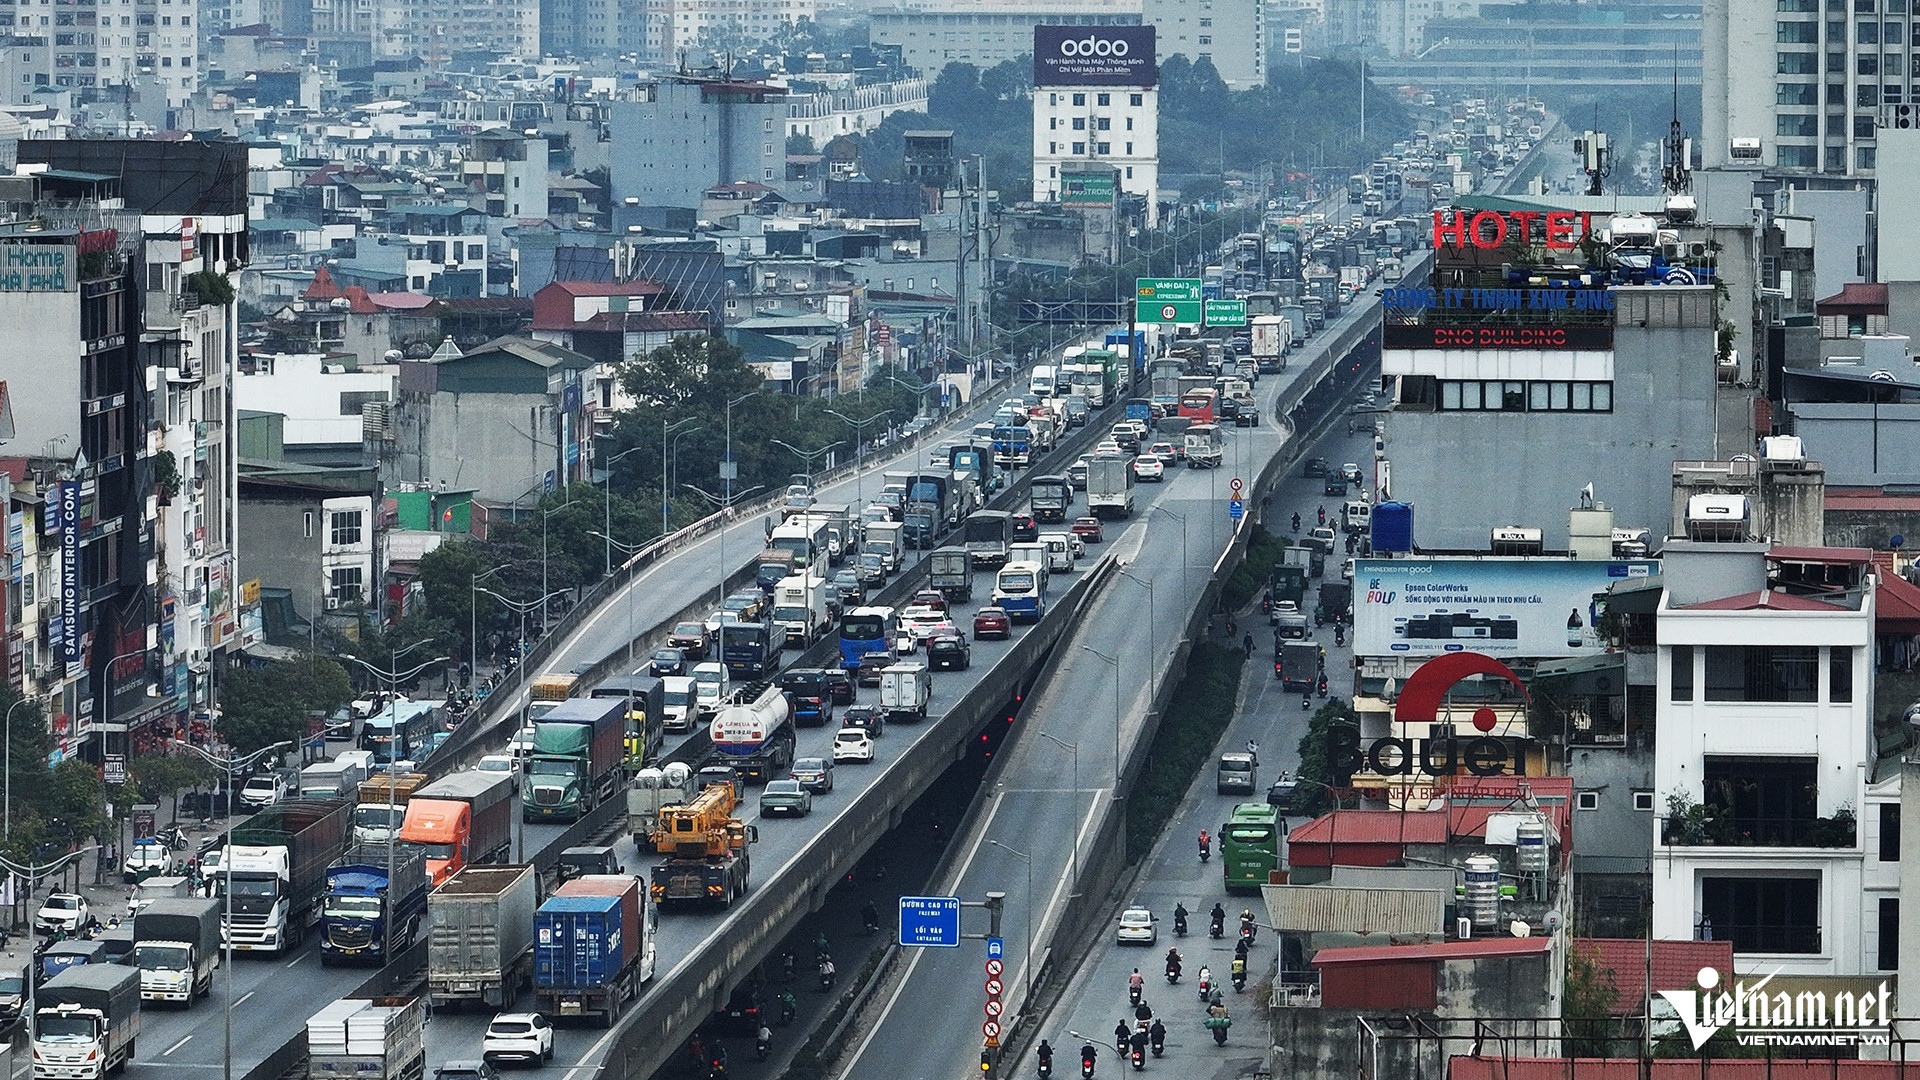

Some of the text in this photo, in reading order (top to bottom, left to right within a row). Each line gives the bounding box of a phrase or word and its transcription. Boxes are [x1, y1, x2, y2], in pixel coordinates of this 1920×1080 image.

[1061, 35, 1129, 56] odoo
[1091, 58, 1105, 66] Máy
[1106, 58, 1127, 66] Thông
[8, 248, 65, 267] Home
[1383, 284, 1437, 309] CÔNG
[1442, 288, 1465, 309] TY
[1471, 288, 1522, 309] TNHH
[1528, 288, 1568, 309] XNK
[1409, 565, 1433, 575] good
[1370, 579, 1380, 589] BE
[1405, 583, 1468, 593] Epson ColorWorks
[1367, 590, 1397, 604] BOLD
[1405, 594, 1422, 603] SỐNG
[1497, 596, 1513, 604] THEO
[1514, 596, 1527, 604] NHU
[1327, 725, 1535, 776] Bauer
[105, 762, 123, 772] HOTEL
[902, 900, 925, 908] ĐƯỜNG
[945, 901, 957, 909] TỐC
[915, 925, 943, 934] LỐI VÀO
